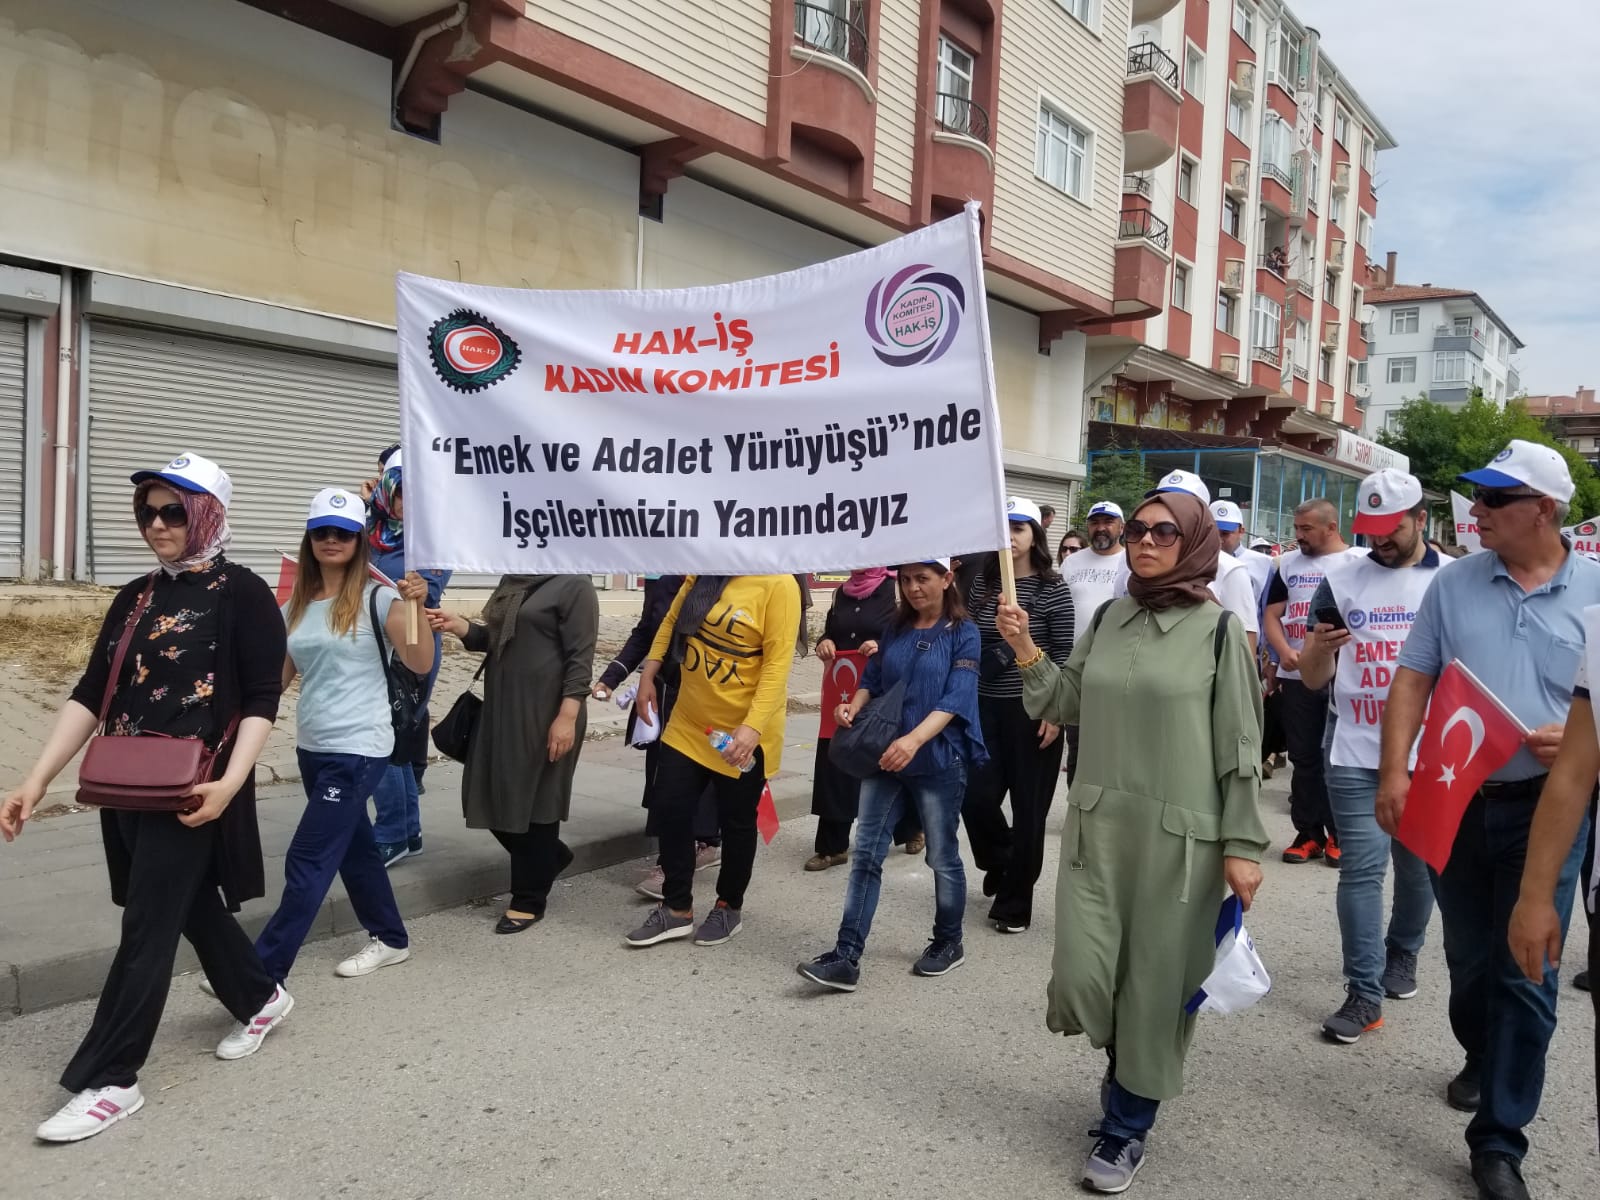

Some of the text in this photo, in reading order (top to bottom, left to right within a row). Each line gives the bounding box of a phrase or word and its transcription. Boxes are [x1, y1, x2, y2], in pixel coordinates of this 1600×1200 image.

[893, 299, 934, 320] KOMİTESİ
[900, 296, 928, 310] KADIN
[613, 312, 753, 357] HAK-İŞ
[544, 341, 840, 394] KADIN KOMİTESİ
[541, 442, 580, 472] ve
[592, 437, 713, 474] Adalet
[502, 491, 908, 548] İşçilerimizin Yanındayız
[1369, 611, 1417, 623] hizme
[1354, 641, 1406, 663] EME
